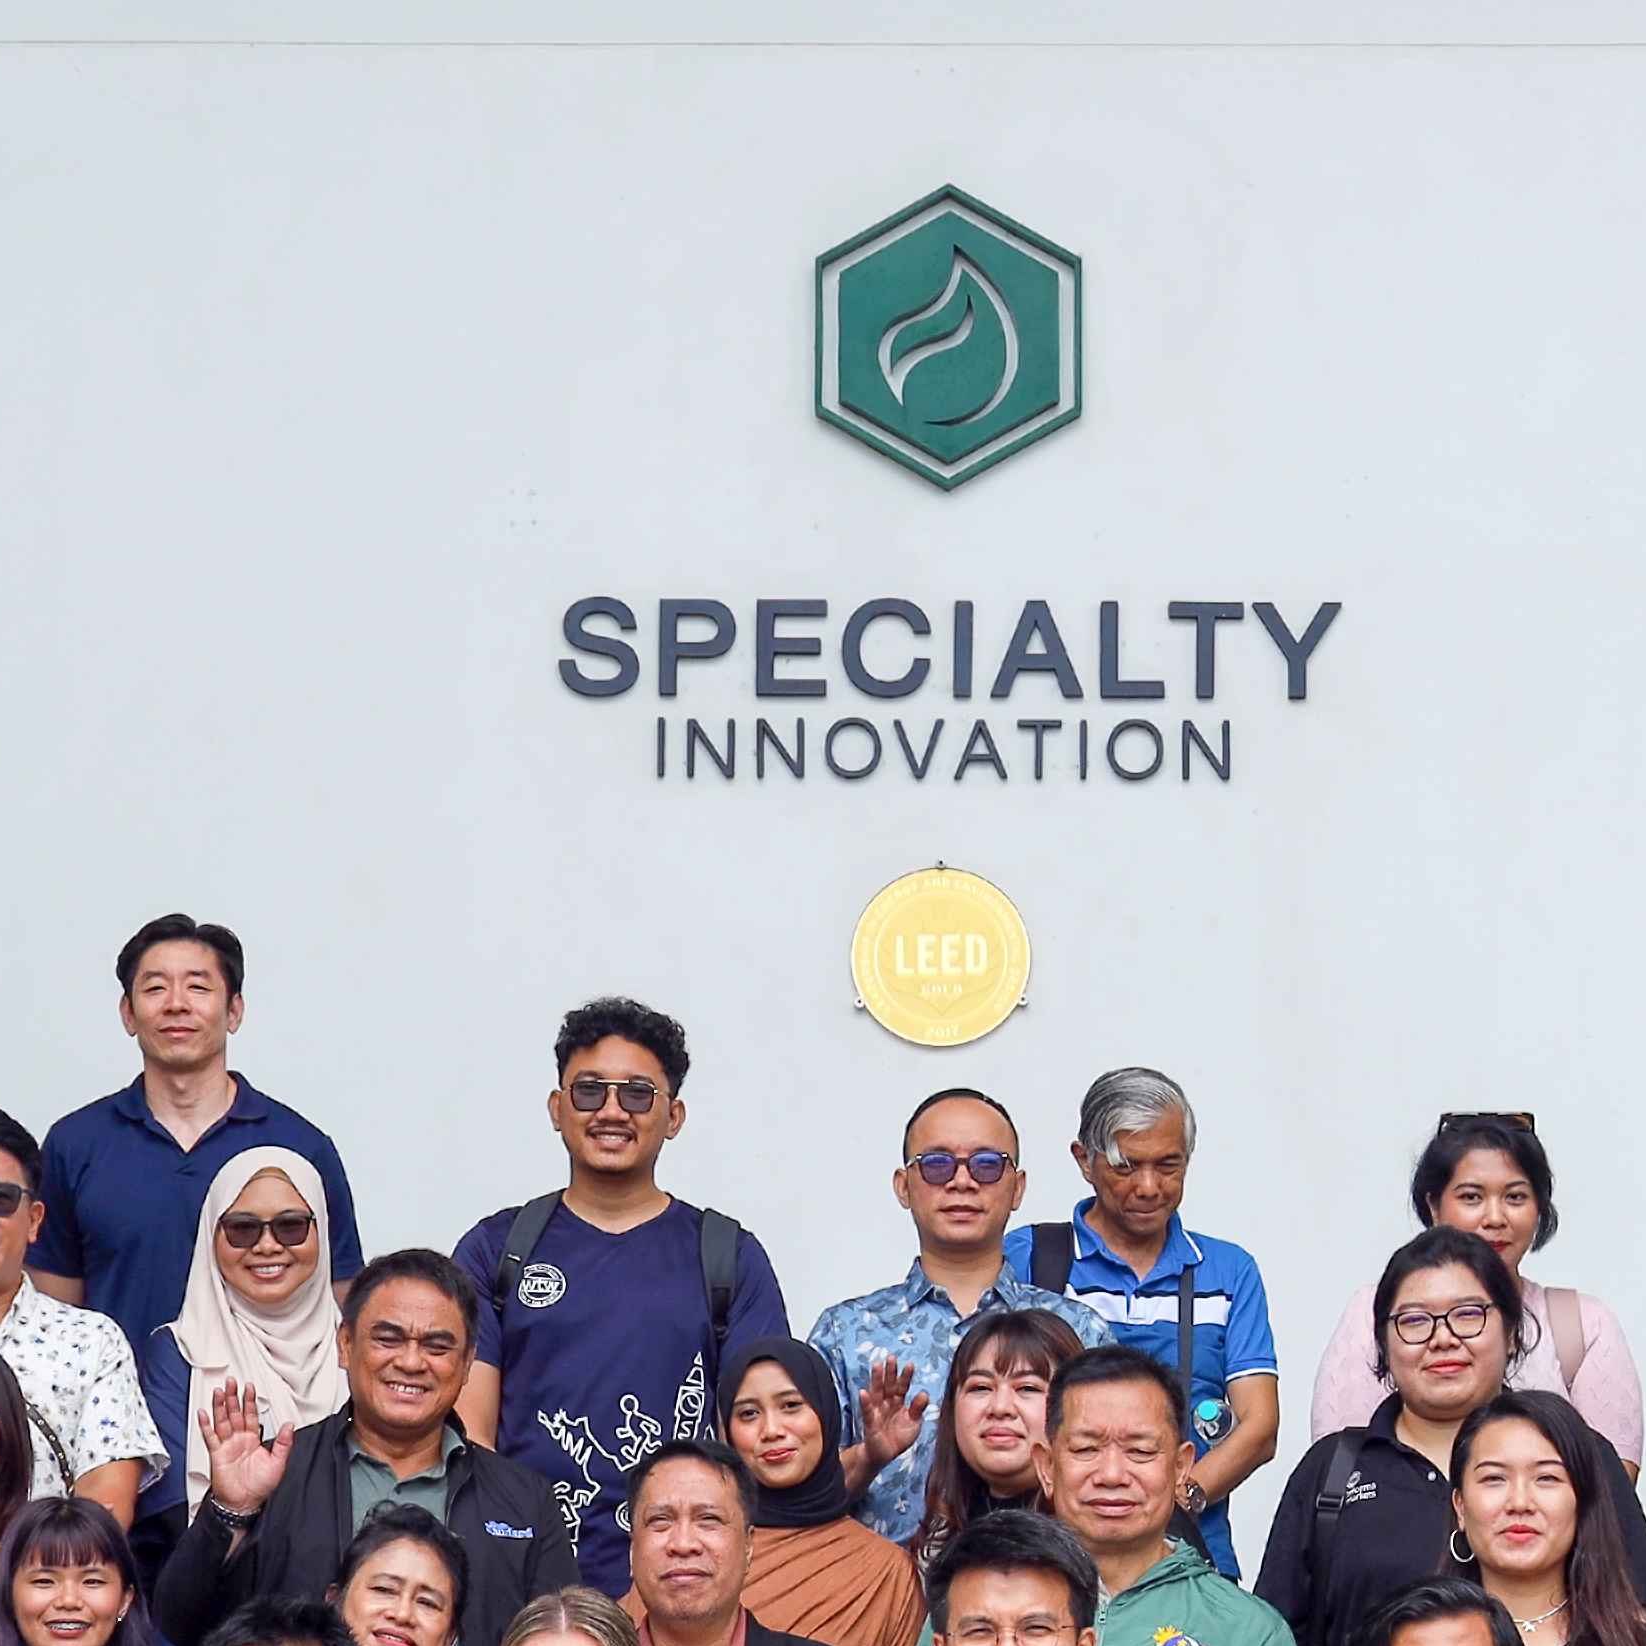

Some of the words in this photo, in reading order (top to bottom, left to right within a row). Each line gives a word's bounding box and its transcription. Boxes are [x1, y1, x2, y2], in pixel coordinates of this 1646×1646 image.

[558, 596, 1342, 702] SPECIALTY
[656, 716, 1231, 782] INNOVATION
[894, 932, 989, 976] LEED
